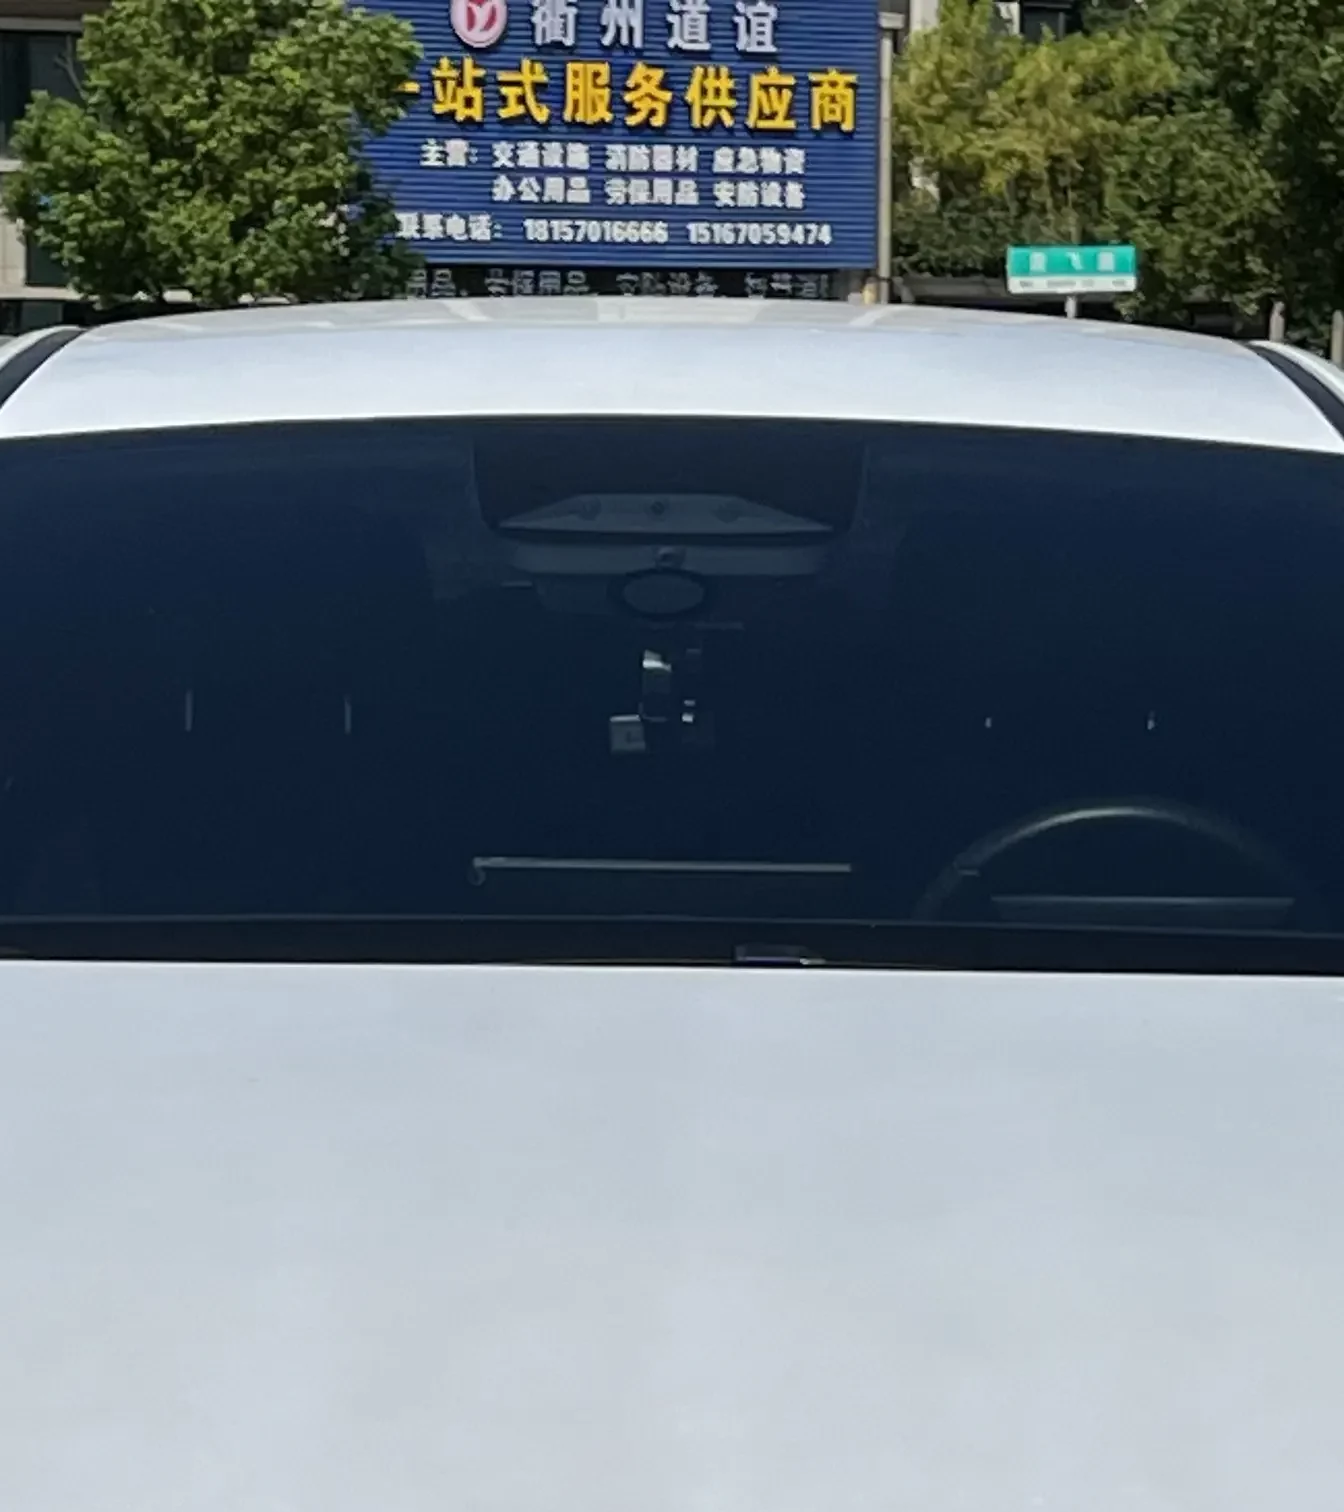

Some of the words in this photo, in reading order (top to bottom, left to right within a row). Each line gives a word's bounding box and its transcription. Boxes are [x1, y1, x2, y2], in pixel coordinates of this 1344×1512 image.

[491, 175, 591, 203] 办公用品
[604, 178, 700, 206] 劳保用品
[523, 217, 669, 244] 18157016666
[685, 220, 833, 247] 15167059474
